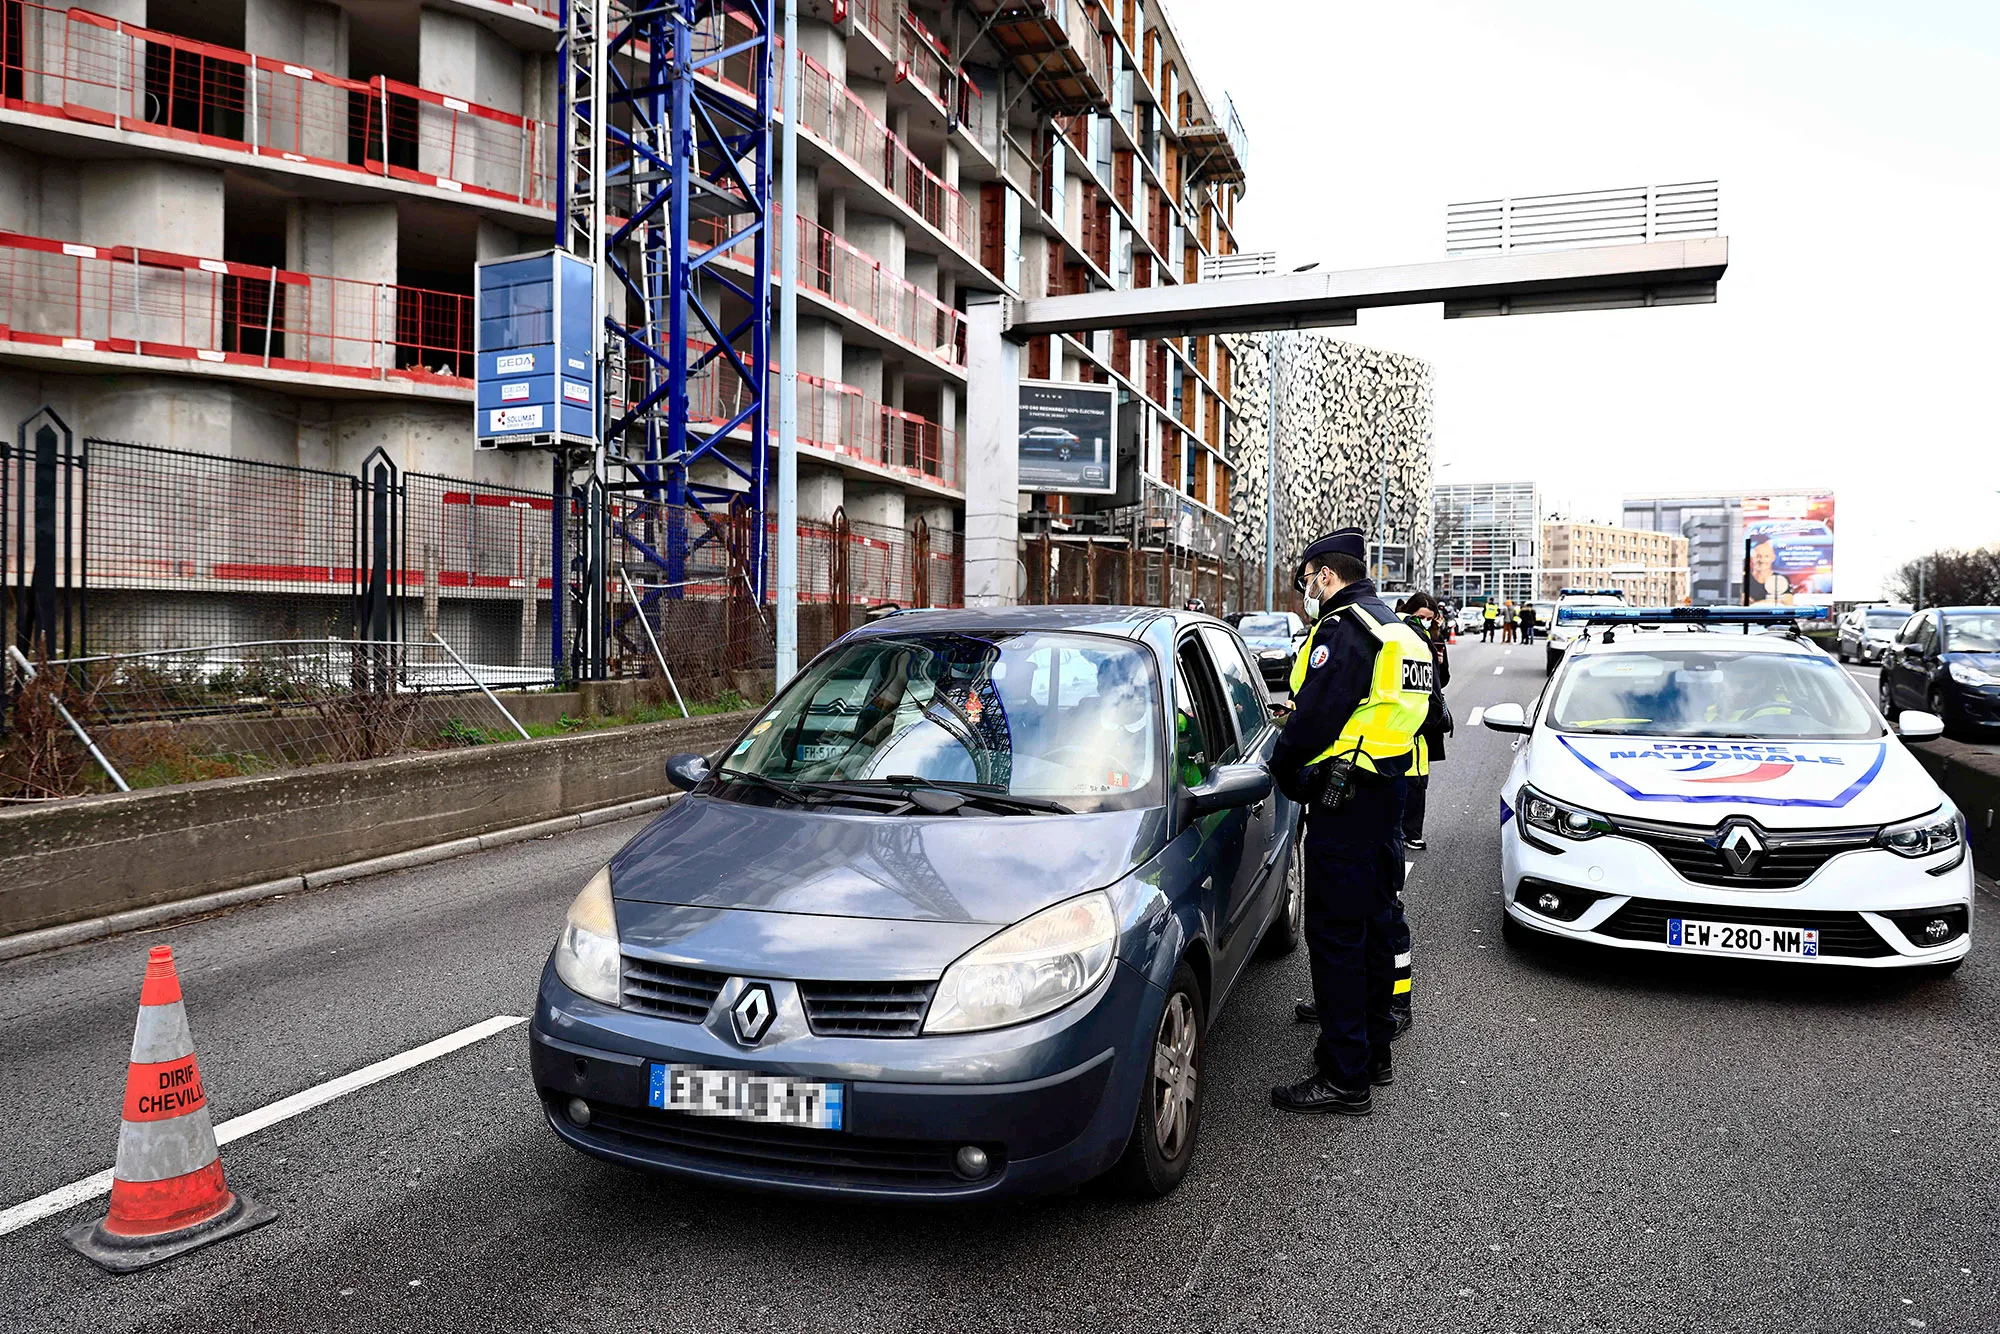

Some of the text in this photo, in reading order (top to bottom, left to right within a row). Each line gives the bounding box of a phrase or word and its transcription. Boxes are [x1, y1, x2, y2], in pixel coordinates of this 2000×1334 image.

[498, 356, 531, 368] GEDA
[503, 385, 527, 394] GEDA
[566, 384, 588, 396] GEDA
[1402, 663, 1432, 688] POLICE
[1653, 743, 1790, 753] POLICE
[1609, 751, 1845, 765] NATIONALE
[1672, 923, 1816, 954] F EW-280-NM 75
[159, 1065, 194, 1090] DIRIF
[654, 1090, 660, 1100] F
